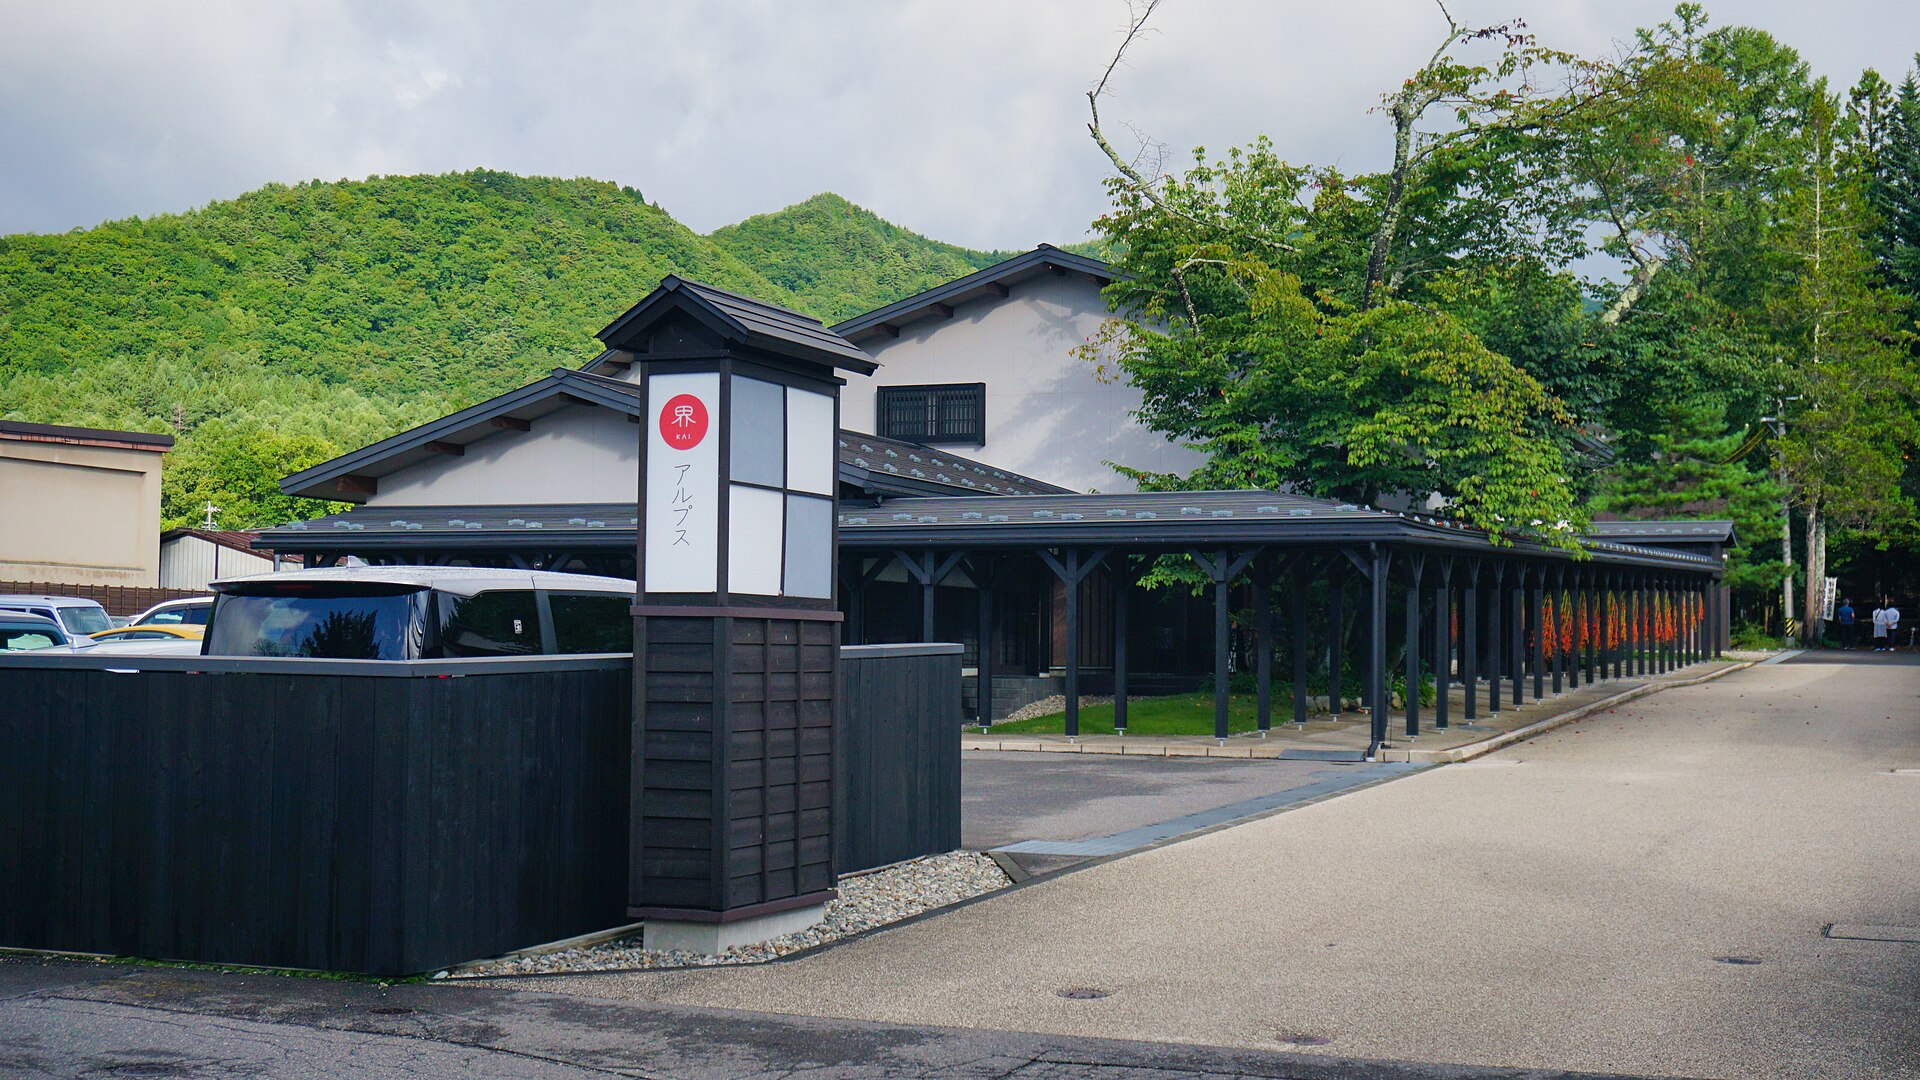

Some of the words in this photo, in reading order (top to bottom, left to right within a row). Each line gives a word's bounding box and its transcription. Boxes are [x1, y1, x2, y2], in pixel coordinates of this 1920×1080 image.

[671, 405, 697, 428] 界
[671, 464, 693, 546] アルプス
